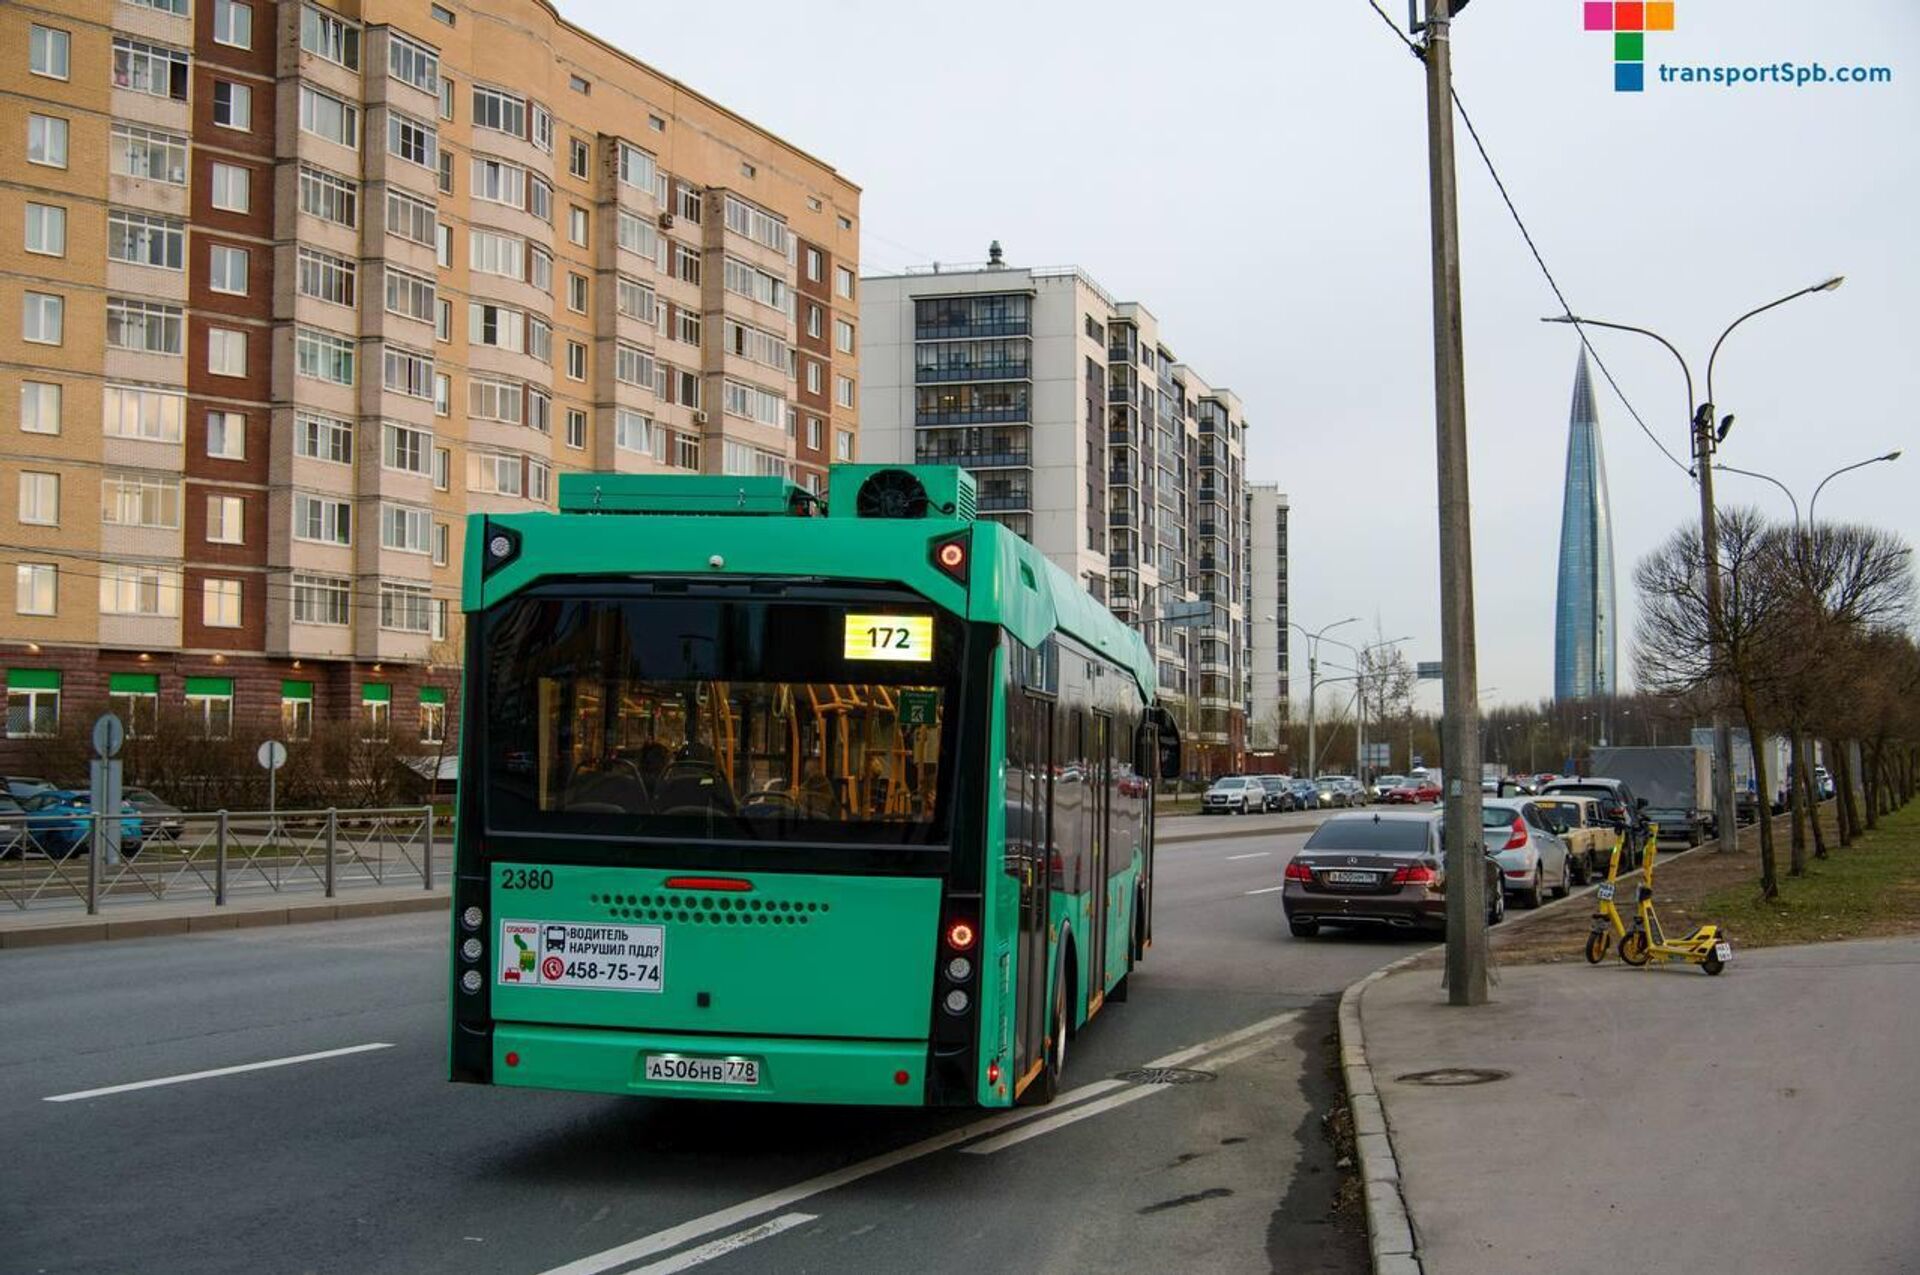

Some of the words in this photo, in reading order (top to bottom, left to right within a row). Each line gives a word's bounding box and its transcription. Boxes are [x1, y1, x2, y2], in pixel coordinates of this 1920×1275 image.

[867, 627, 911, 649] 172
[501, 868, 553, 890] 2380
[569, 928, 629, 942] ВОДИТЕЛЬ
[569, 942, 625, 956] НАРУШИЛ
[628, 945, 660, 958] ПДД?
[565, 962, 660, 982] 458-75-74
[727, 1062, 755, 1078] 778
